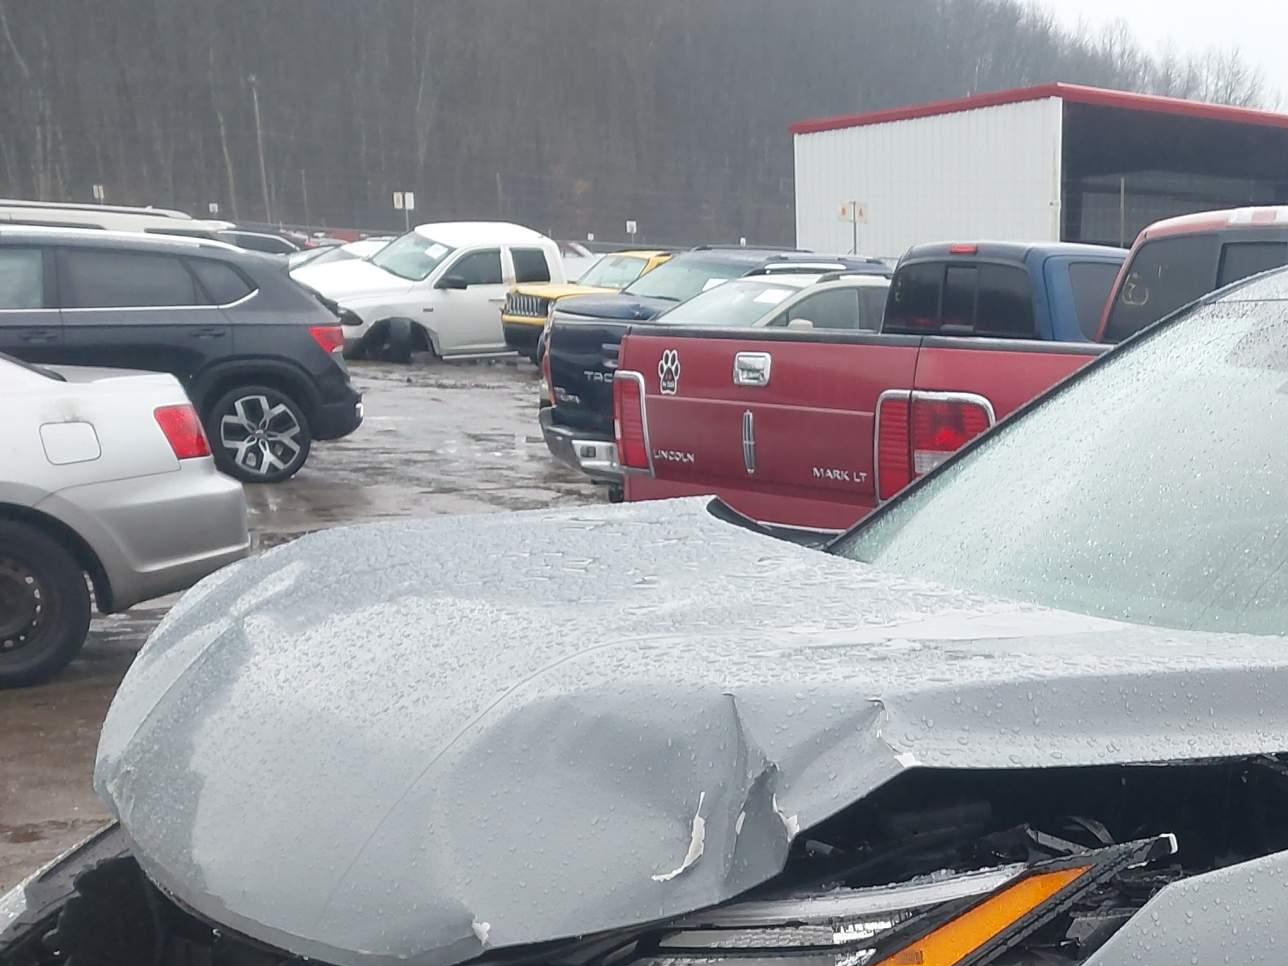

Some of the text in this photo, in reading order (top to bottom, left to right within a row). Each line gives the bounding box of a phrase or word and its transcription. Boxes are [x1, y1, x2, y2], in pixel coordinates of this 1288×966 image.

[653, 449, 695, 463] LINCOLN
[812, 466, 867, 482] MARK LT
